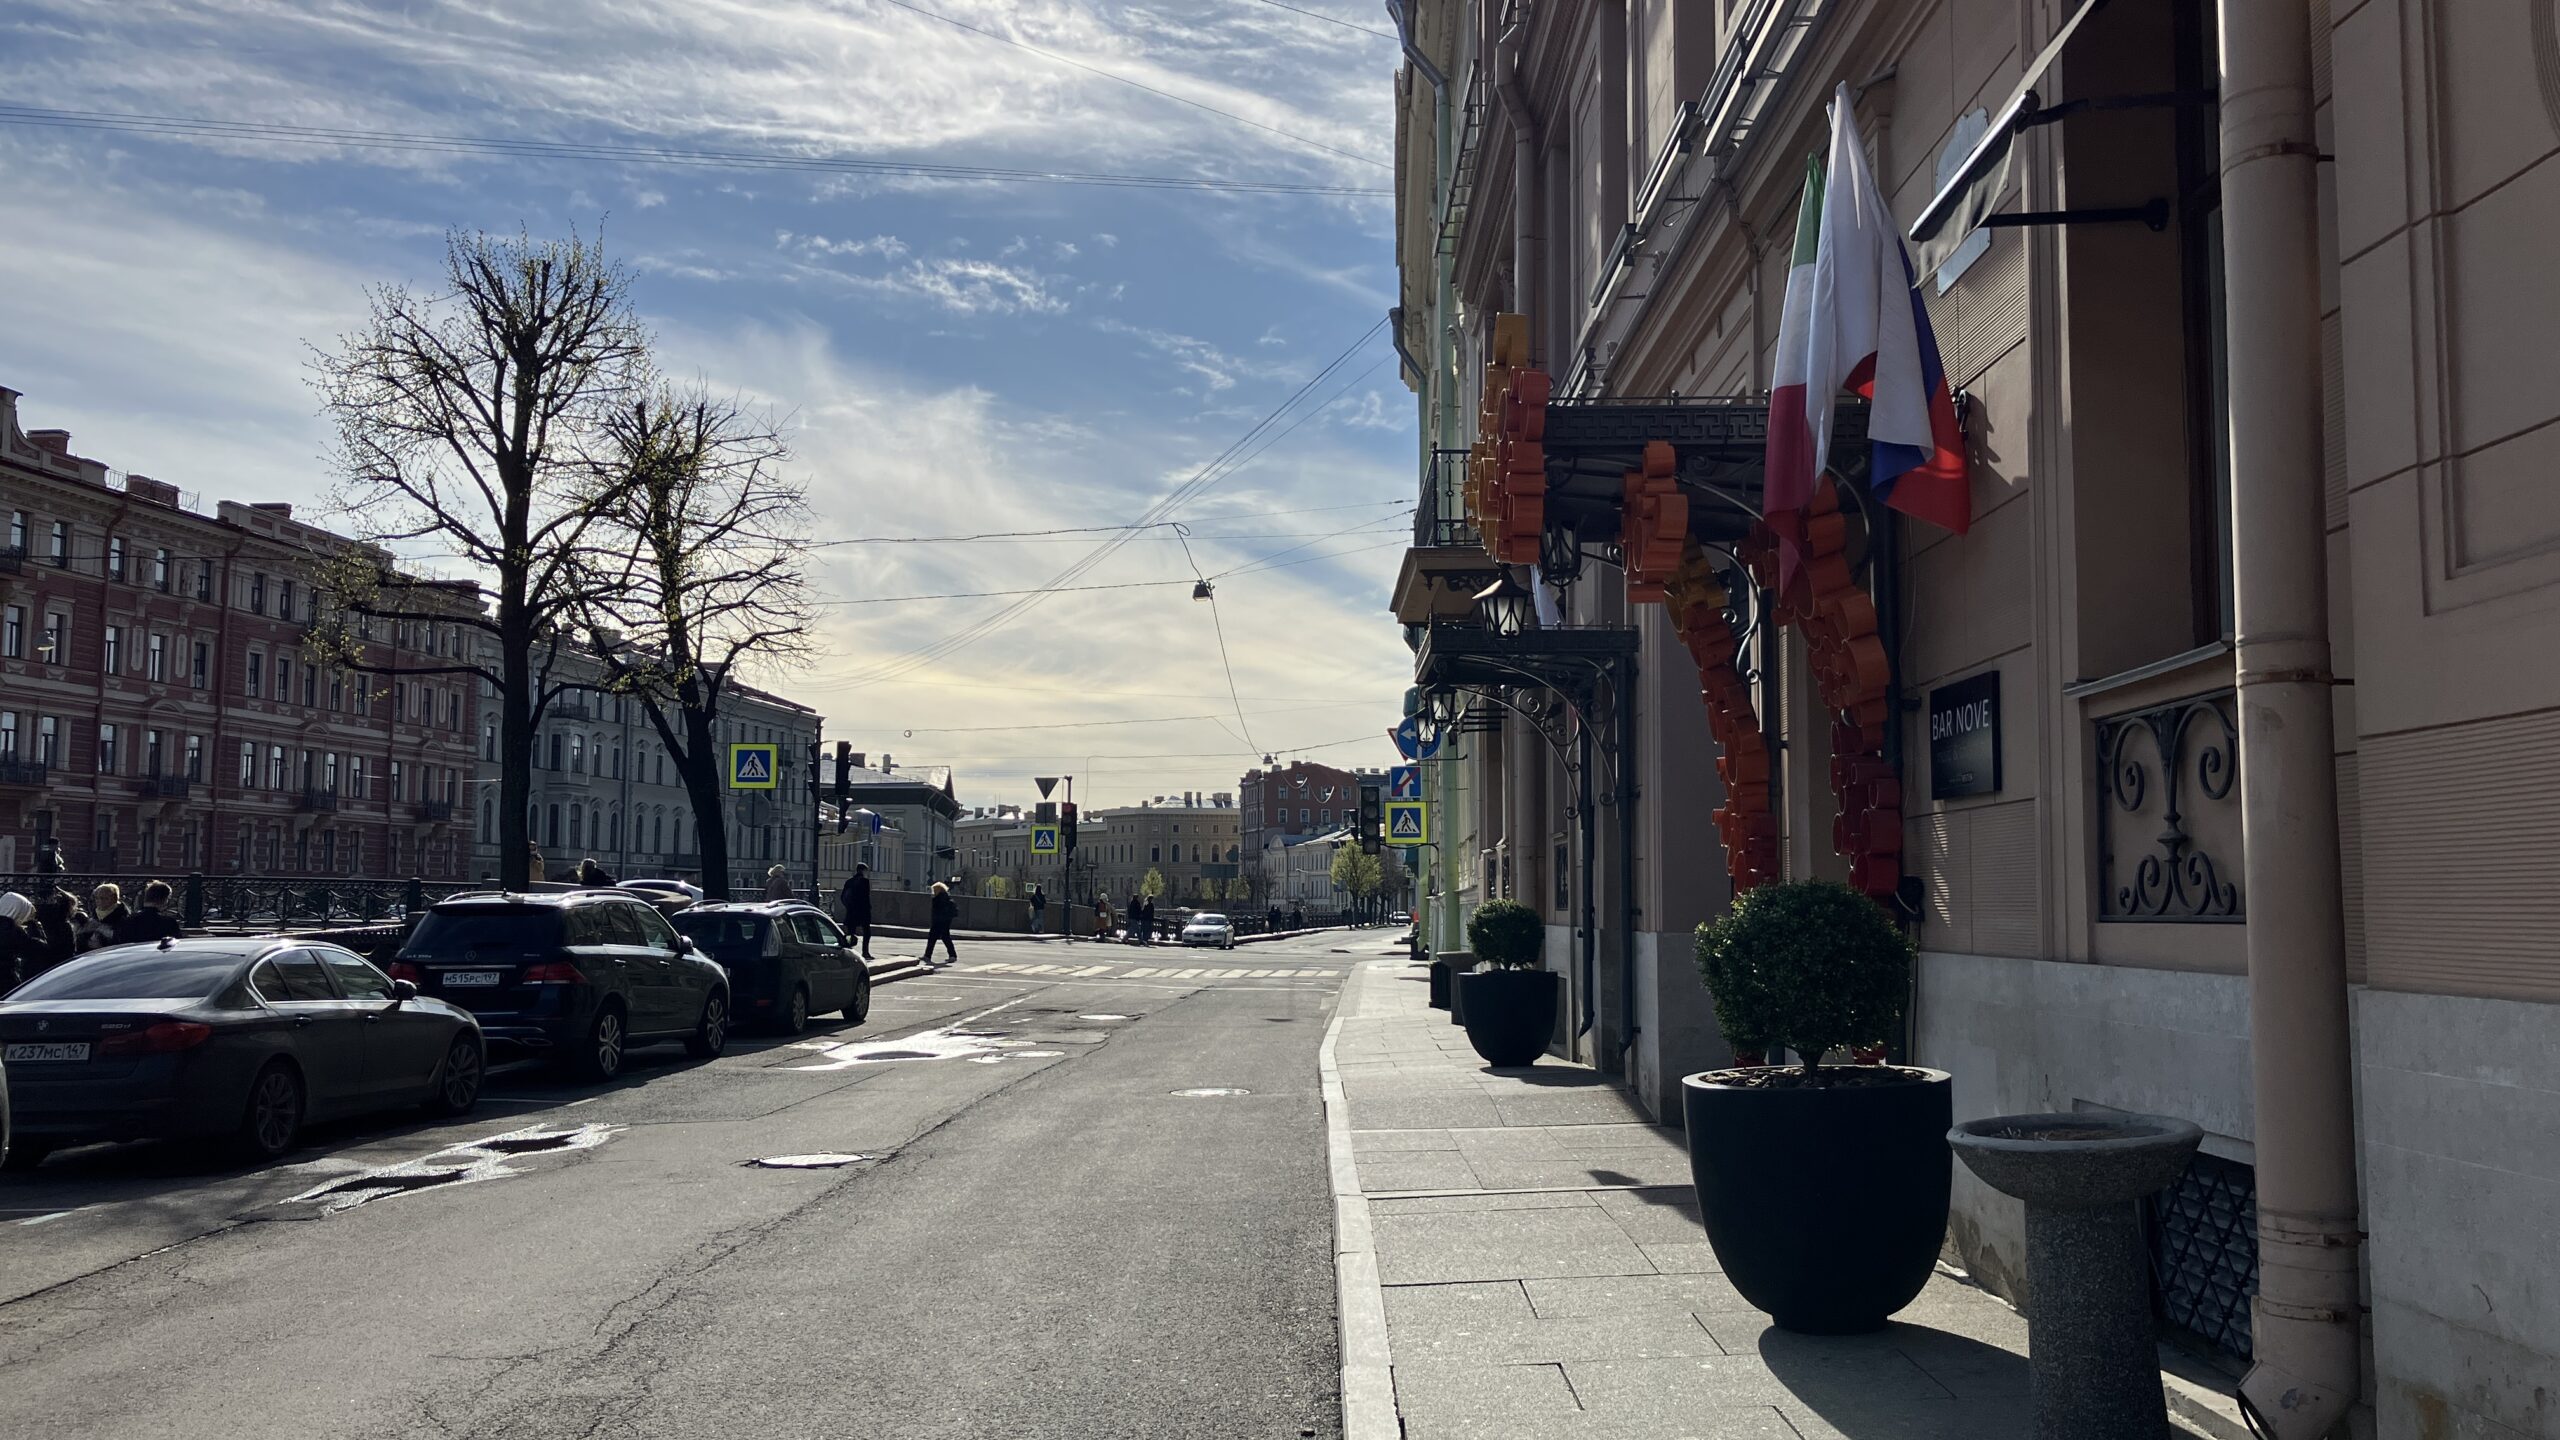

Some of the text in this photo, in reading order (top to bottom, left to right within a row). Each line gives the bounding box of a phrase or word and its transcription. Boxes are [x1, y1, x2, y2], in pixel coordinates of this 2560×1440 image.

[1932, 698, 1990, 741] BAR NOVE
[65, 1044, 86, 1055] 147
